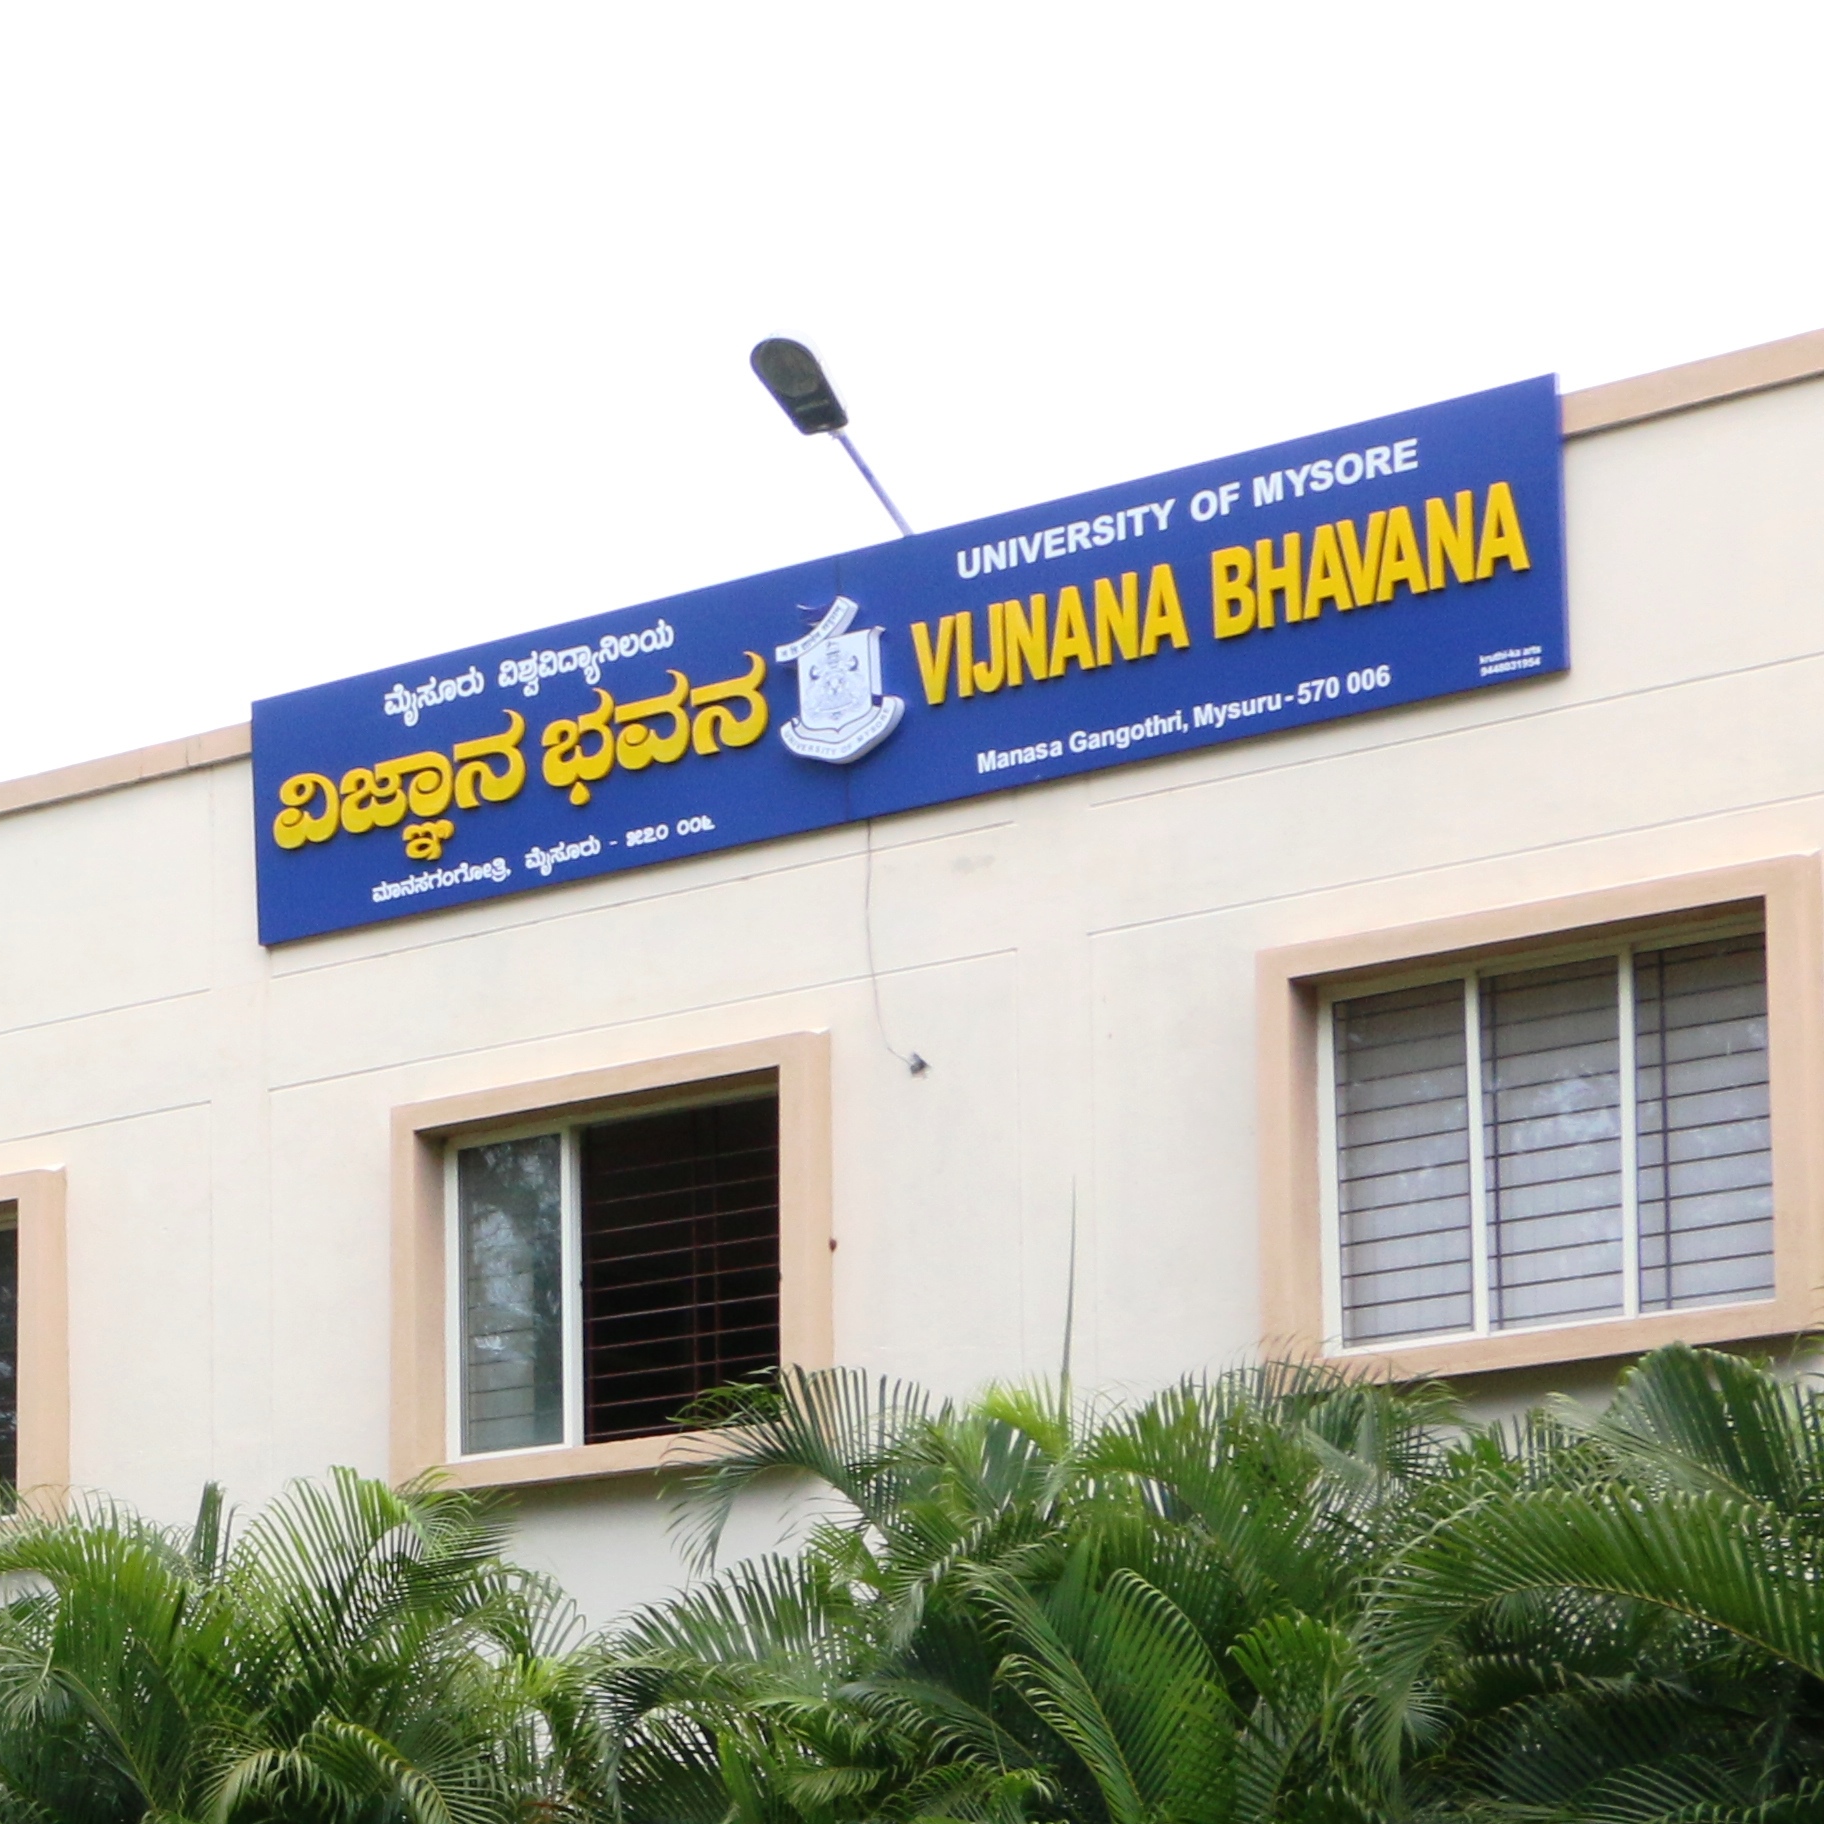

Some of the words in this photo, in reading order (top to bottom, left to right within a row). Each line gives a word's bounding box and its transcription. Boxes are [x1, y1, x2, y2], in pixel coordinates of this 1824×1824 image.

[957, 500, 1175, 580] UNIVERSITY
[1190, 482, 1242, 523] OF
[1253, 438, 1419, 507] MYSORE
[910, 563, 1190, 706] VIJNANA
[1210, 481, 1531, 641] BHAVANA
[384, 666, 485, 727] ಮೈಸೂರು
[498, 619, 675, 697] ವಿಶ್ವವಿದ್ಯಾನಿಲಯ
[977, 739, 1064, 775] Manasa
[1069, 707, 1188, 754] Gangothri,
[1298, 676, 1340, 706] 570
[1347, 664, 1392, 694] 006
[272, 709, 527, 861] ವಿಜ್ಞಾನ
[542, 651, 769, 806] ಭವನ
[524, 836, 601, 877] ಮೈಸೂರು
